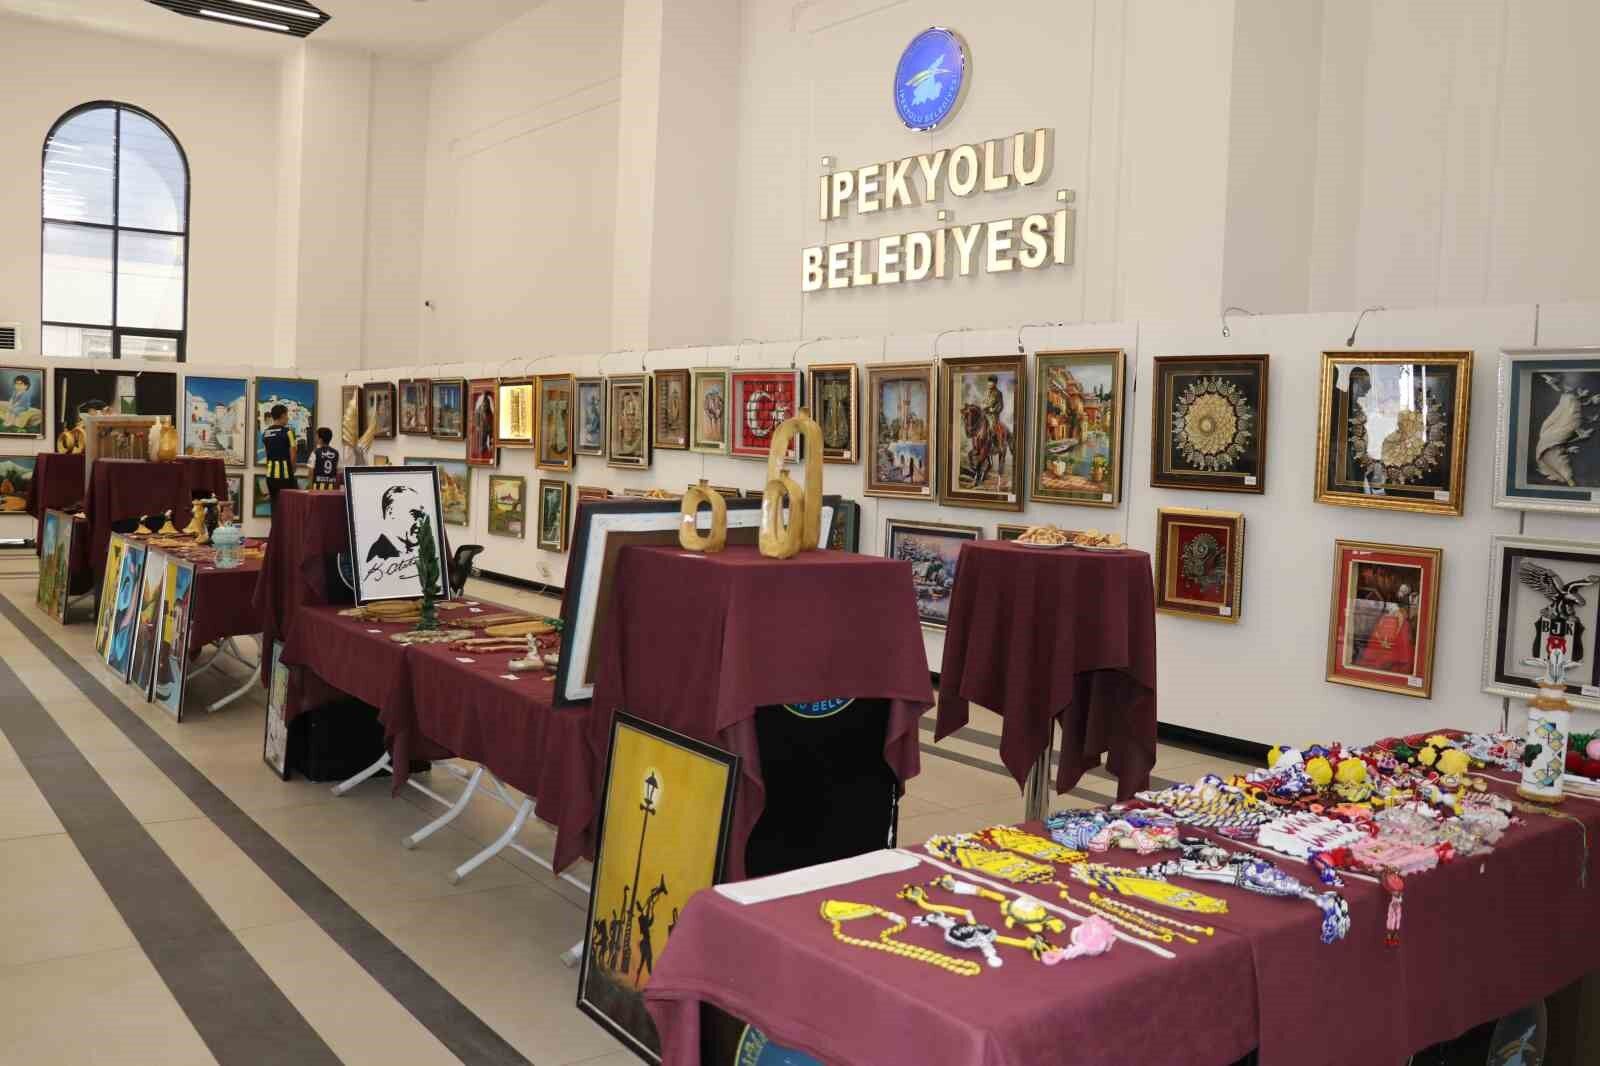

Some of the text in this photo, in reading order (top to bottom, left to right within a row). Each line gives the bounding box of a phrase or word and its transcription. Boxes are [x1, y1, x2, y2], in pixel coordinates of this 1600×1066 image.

[819, 129, 1049, 221] İPEKYOLU
[801, 189, 1071, 292] BELEDİYESİ
[324, 460, 333, 474] 9
[1542, 620, 1574, 636] BJK
